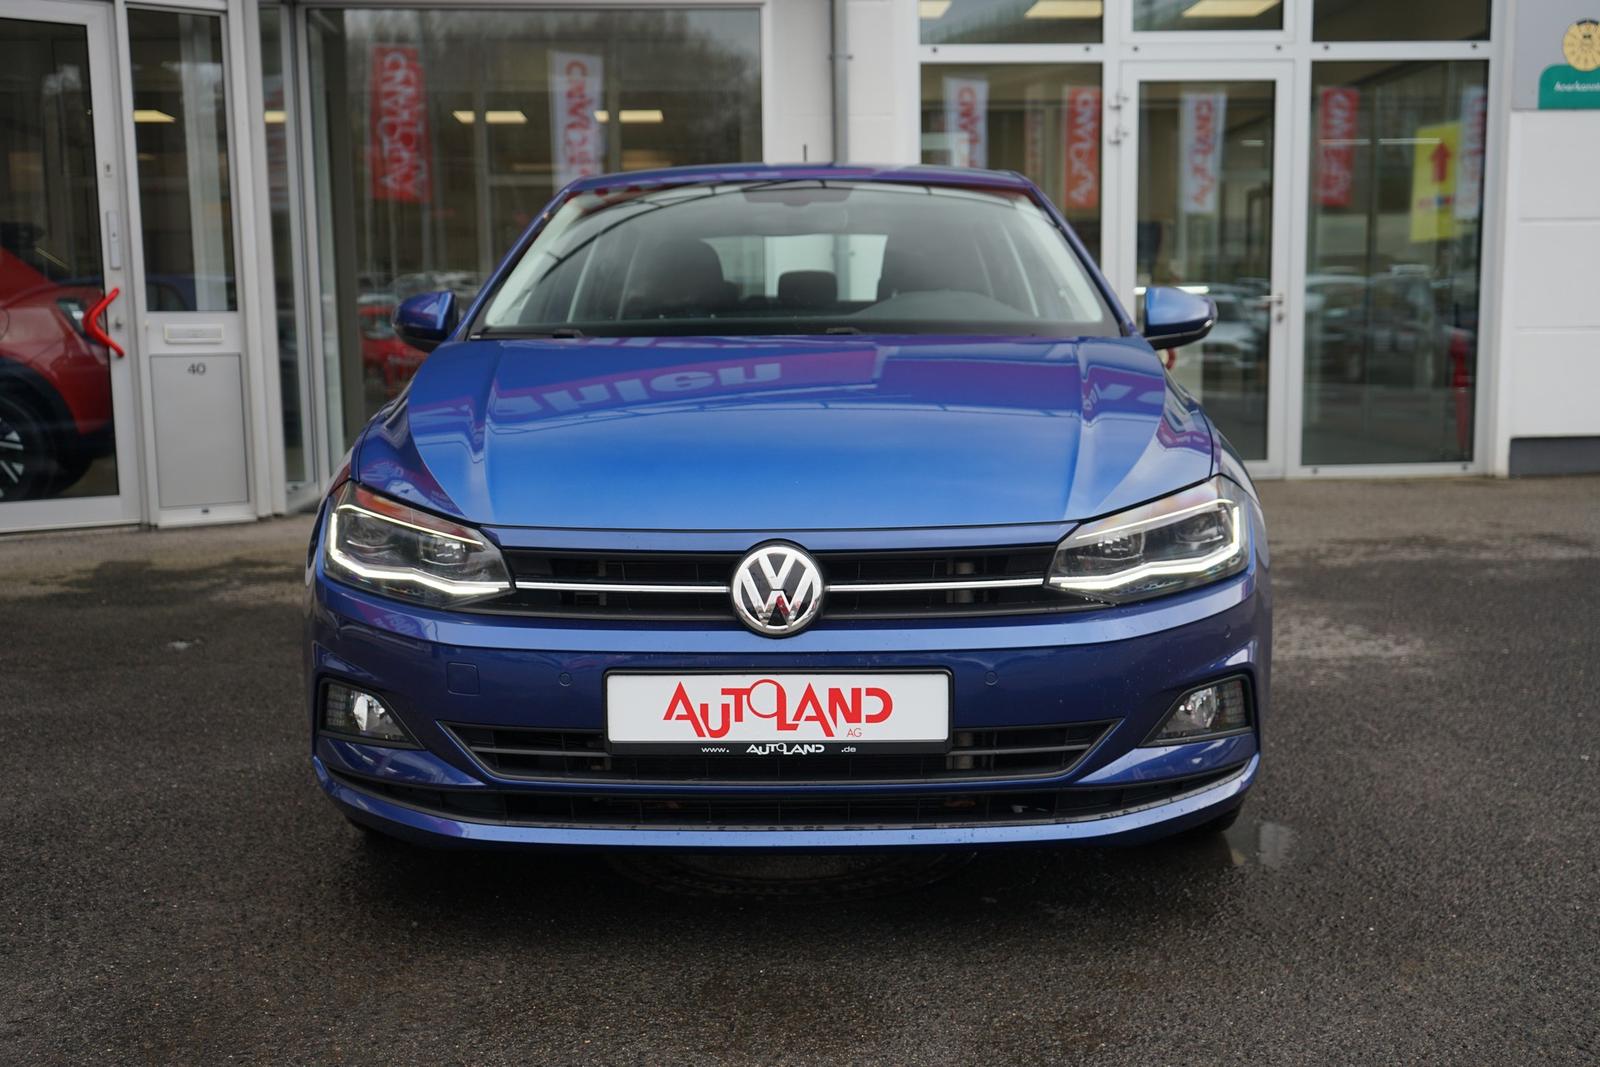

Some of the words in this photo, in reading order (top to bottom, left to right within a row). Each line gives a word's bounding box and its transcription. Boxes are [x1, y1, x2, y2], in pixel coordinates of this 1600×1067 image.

[187, 363, 206, 376] 40
[733, 547, 822, 634] VW
[663, 679, 893, 738] AUTOLAND
[846, 727, 862, 737] AG
